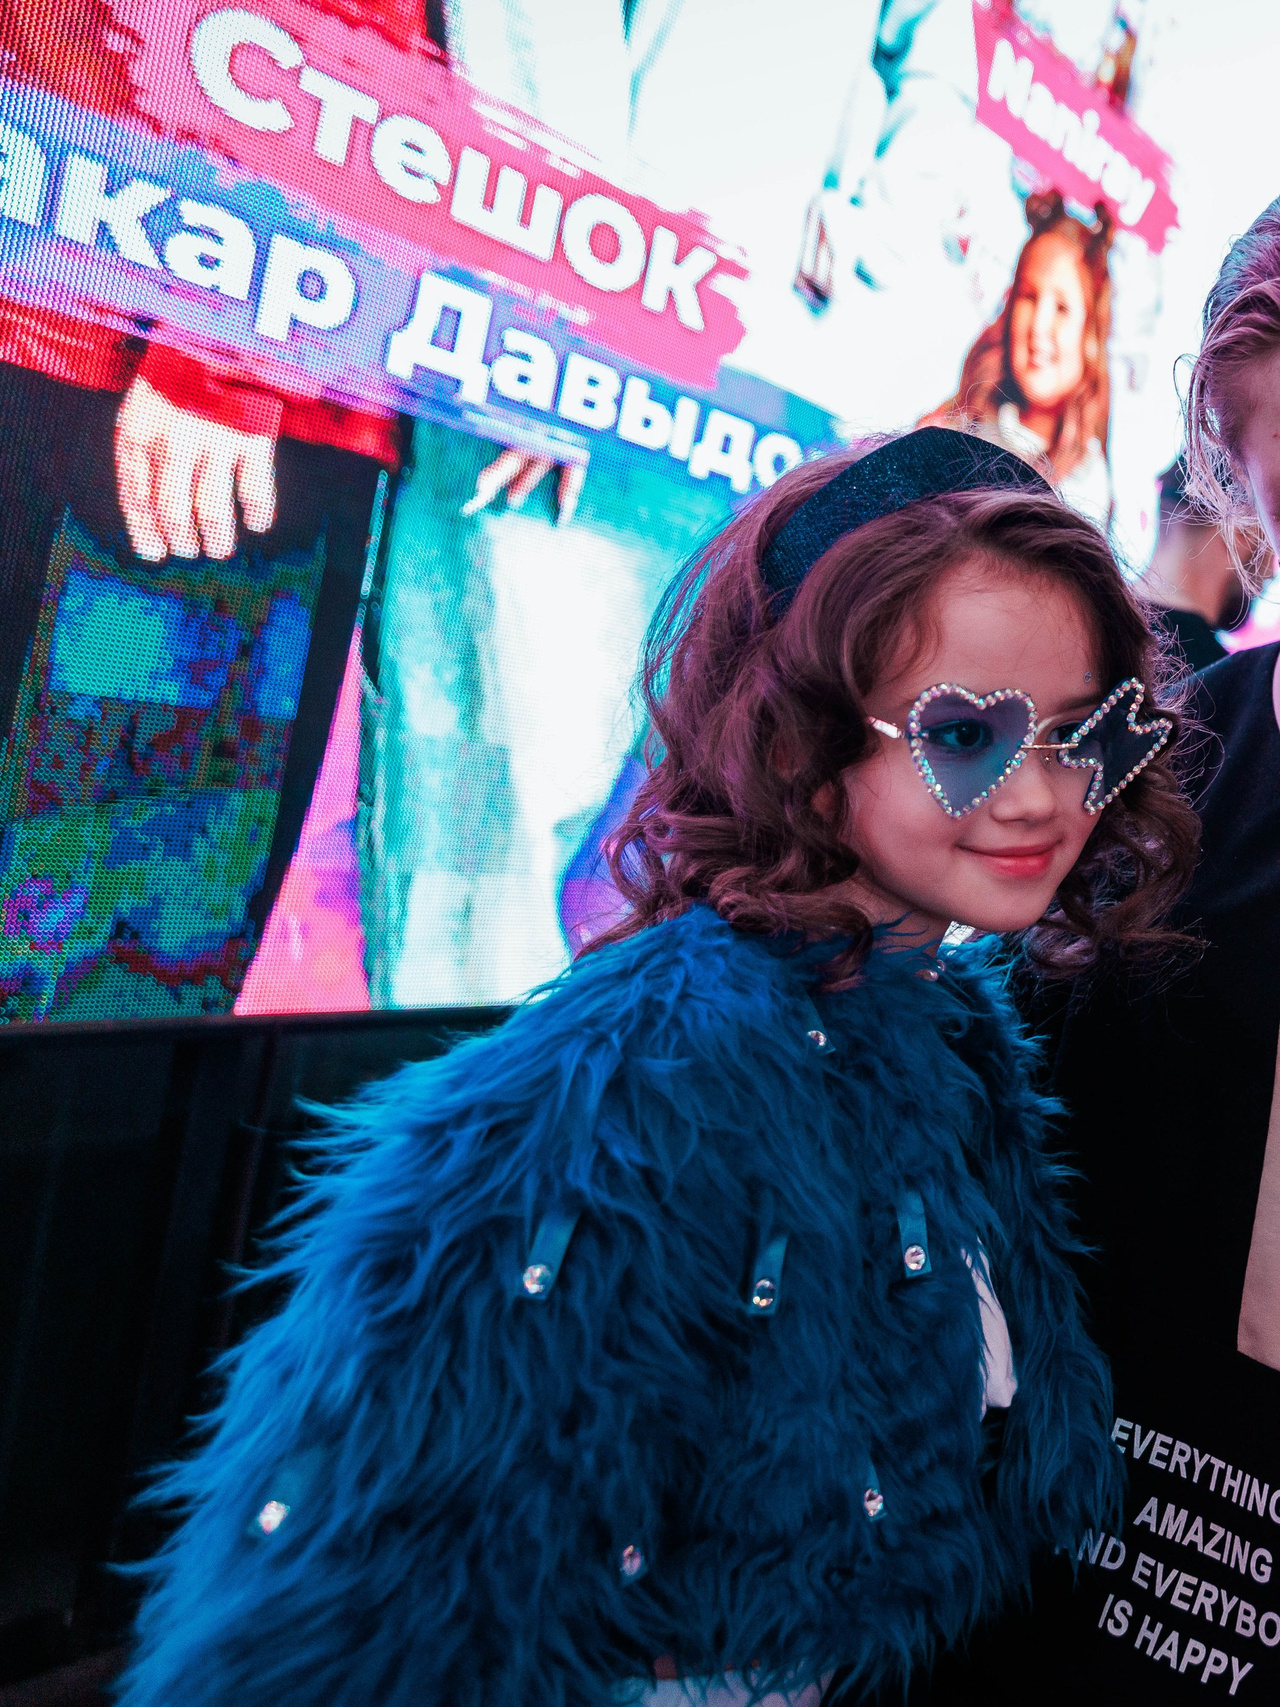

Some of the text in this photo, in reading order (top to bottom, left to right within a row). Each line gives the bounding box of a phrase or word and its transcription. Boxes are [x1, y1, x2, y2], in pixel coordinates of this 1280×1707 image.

[1058, 1527, 1127, 1571] ND
[1132, 1496, 1274, 1584] AMAZING
[1097, 1593, 1254, 1696] IS HAPPY
